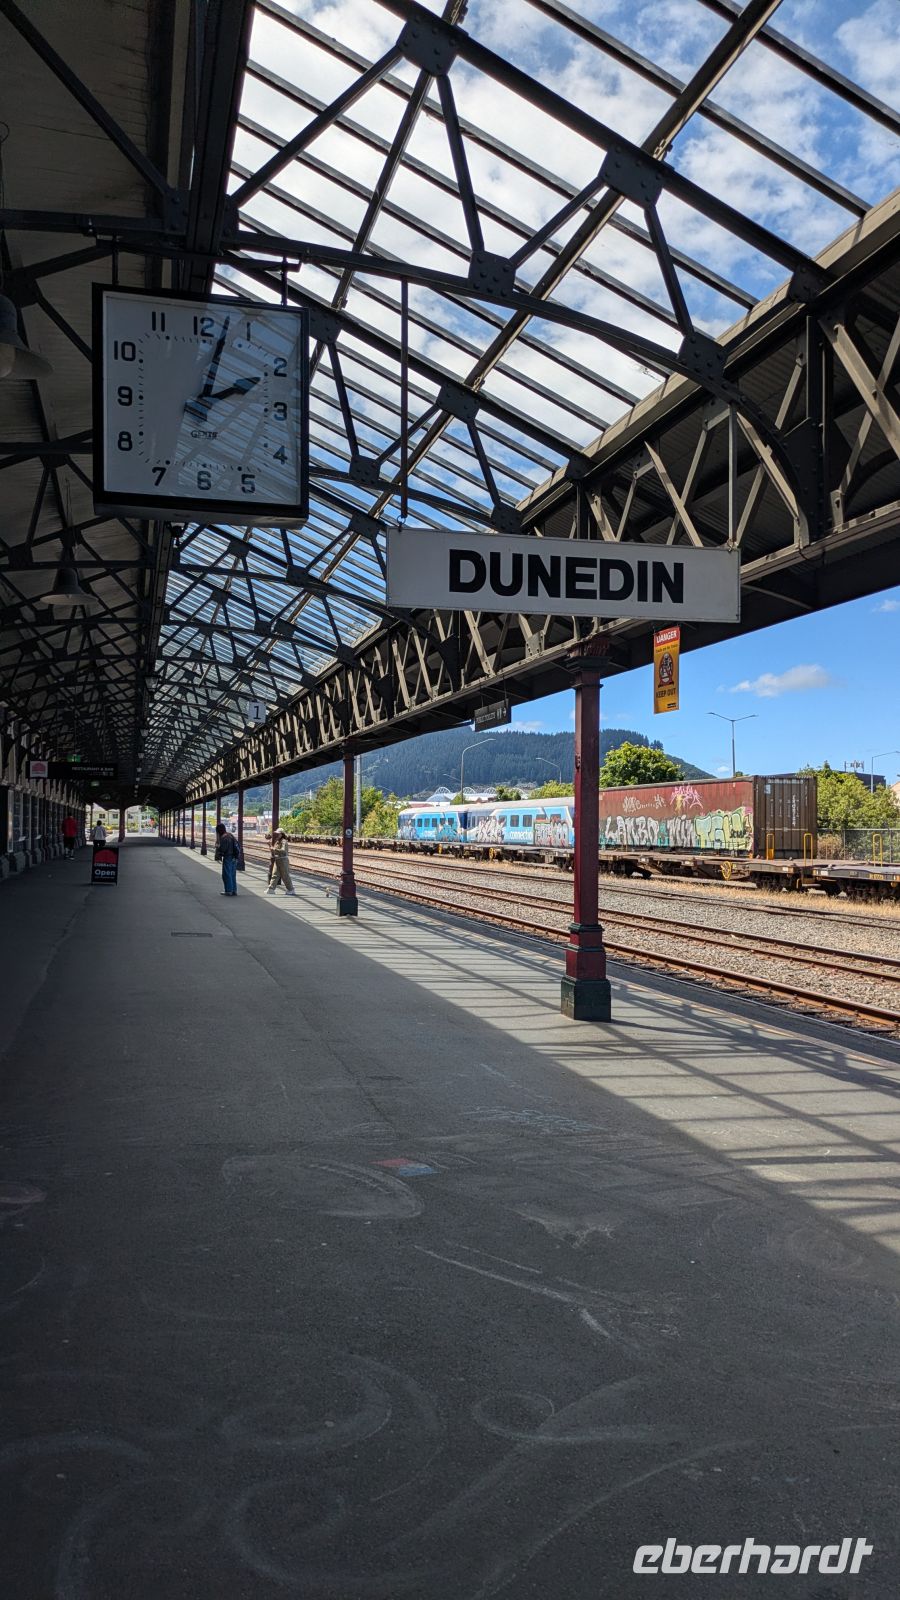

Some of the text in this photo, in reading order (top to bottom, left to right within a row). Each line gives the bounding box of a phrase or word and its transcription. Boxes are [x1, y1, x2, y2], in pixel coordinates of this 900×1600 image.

[152, 312, 165, 332] 11
[193, 316, 215, 338] 12
[246, 322, 251, 341] 1
[113, 340, 136, 361] 10
[273, 357, 288, 377] 2
[117, 386, 132, 406] 9
[273, 401, 288, 421] 3
[117, 431, 133, 451] 8
[273, 445, 288, 465] 4
[152, 466, 166, 486] 7
[197, 470, 212, 490] 6
[241, 474, 256, 494] 5
[449, 549, 684, 603] DUNEDIN
[656, 630, 677, 644] DANGER
[656, 688, 676, 698] KEEP OUT
[253, 705, 261, 719] 1
[94, 869, 116, 877] Open
